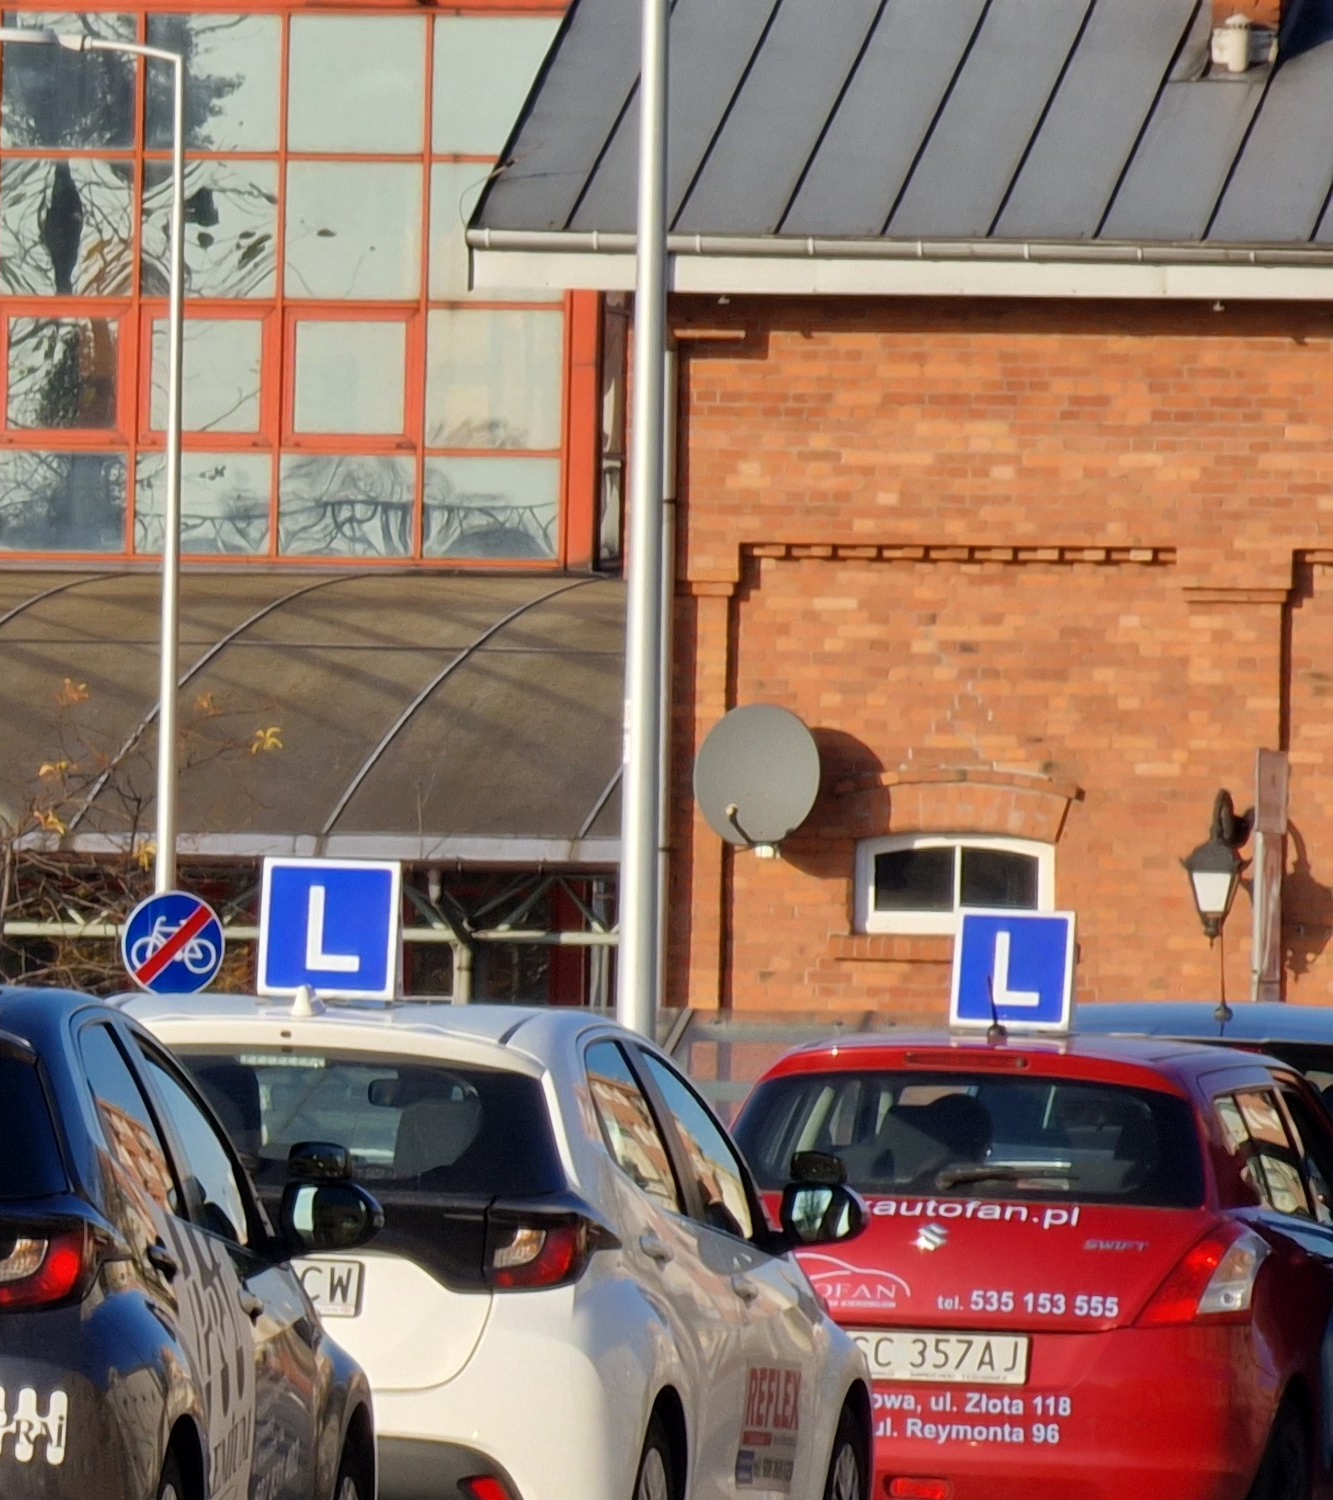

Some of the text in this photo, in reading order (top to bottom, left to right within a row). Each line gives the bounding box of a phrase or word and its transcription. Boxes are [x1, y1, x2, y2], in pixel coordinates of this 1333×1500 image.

[306, 885, 360, 972] L
[993, 931, 1040, 1007] L
[866, 1199, 1080, 1230] autofan.pl
[300, 1266, 352, 1303] CW
[814, 1283, 896, 1300] OFAN
[970, 1290, 1015, 1312] 535
[1023, 1292, 1066, 1315] 153
[1074, 1295, 1119, 1317] 555
[909, 1338, 1018, 1372] 357AJ
[745, 1367, 801, 1430] REFLEX
[873, 1391, 1071, 1417] owa, ul. Złota 118
[906, 1418, 1024, 1444] Reymonta
[1032, 1423, 1060, 1444] 96
